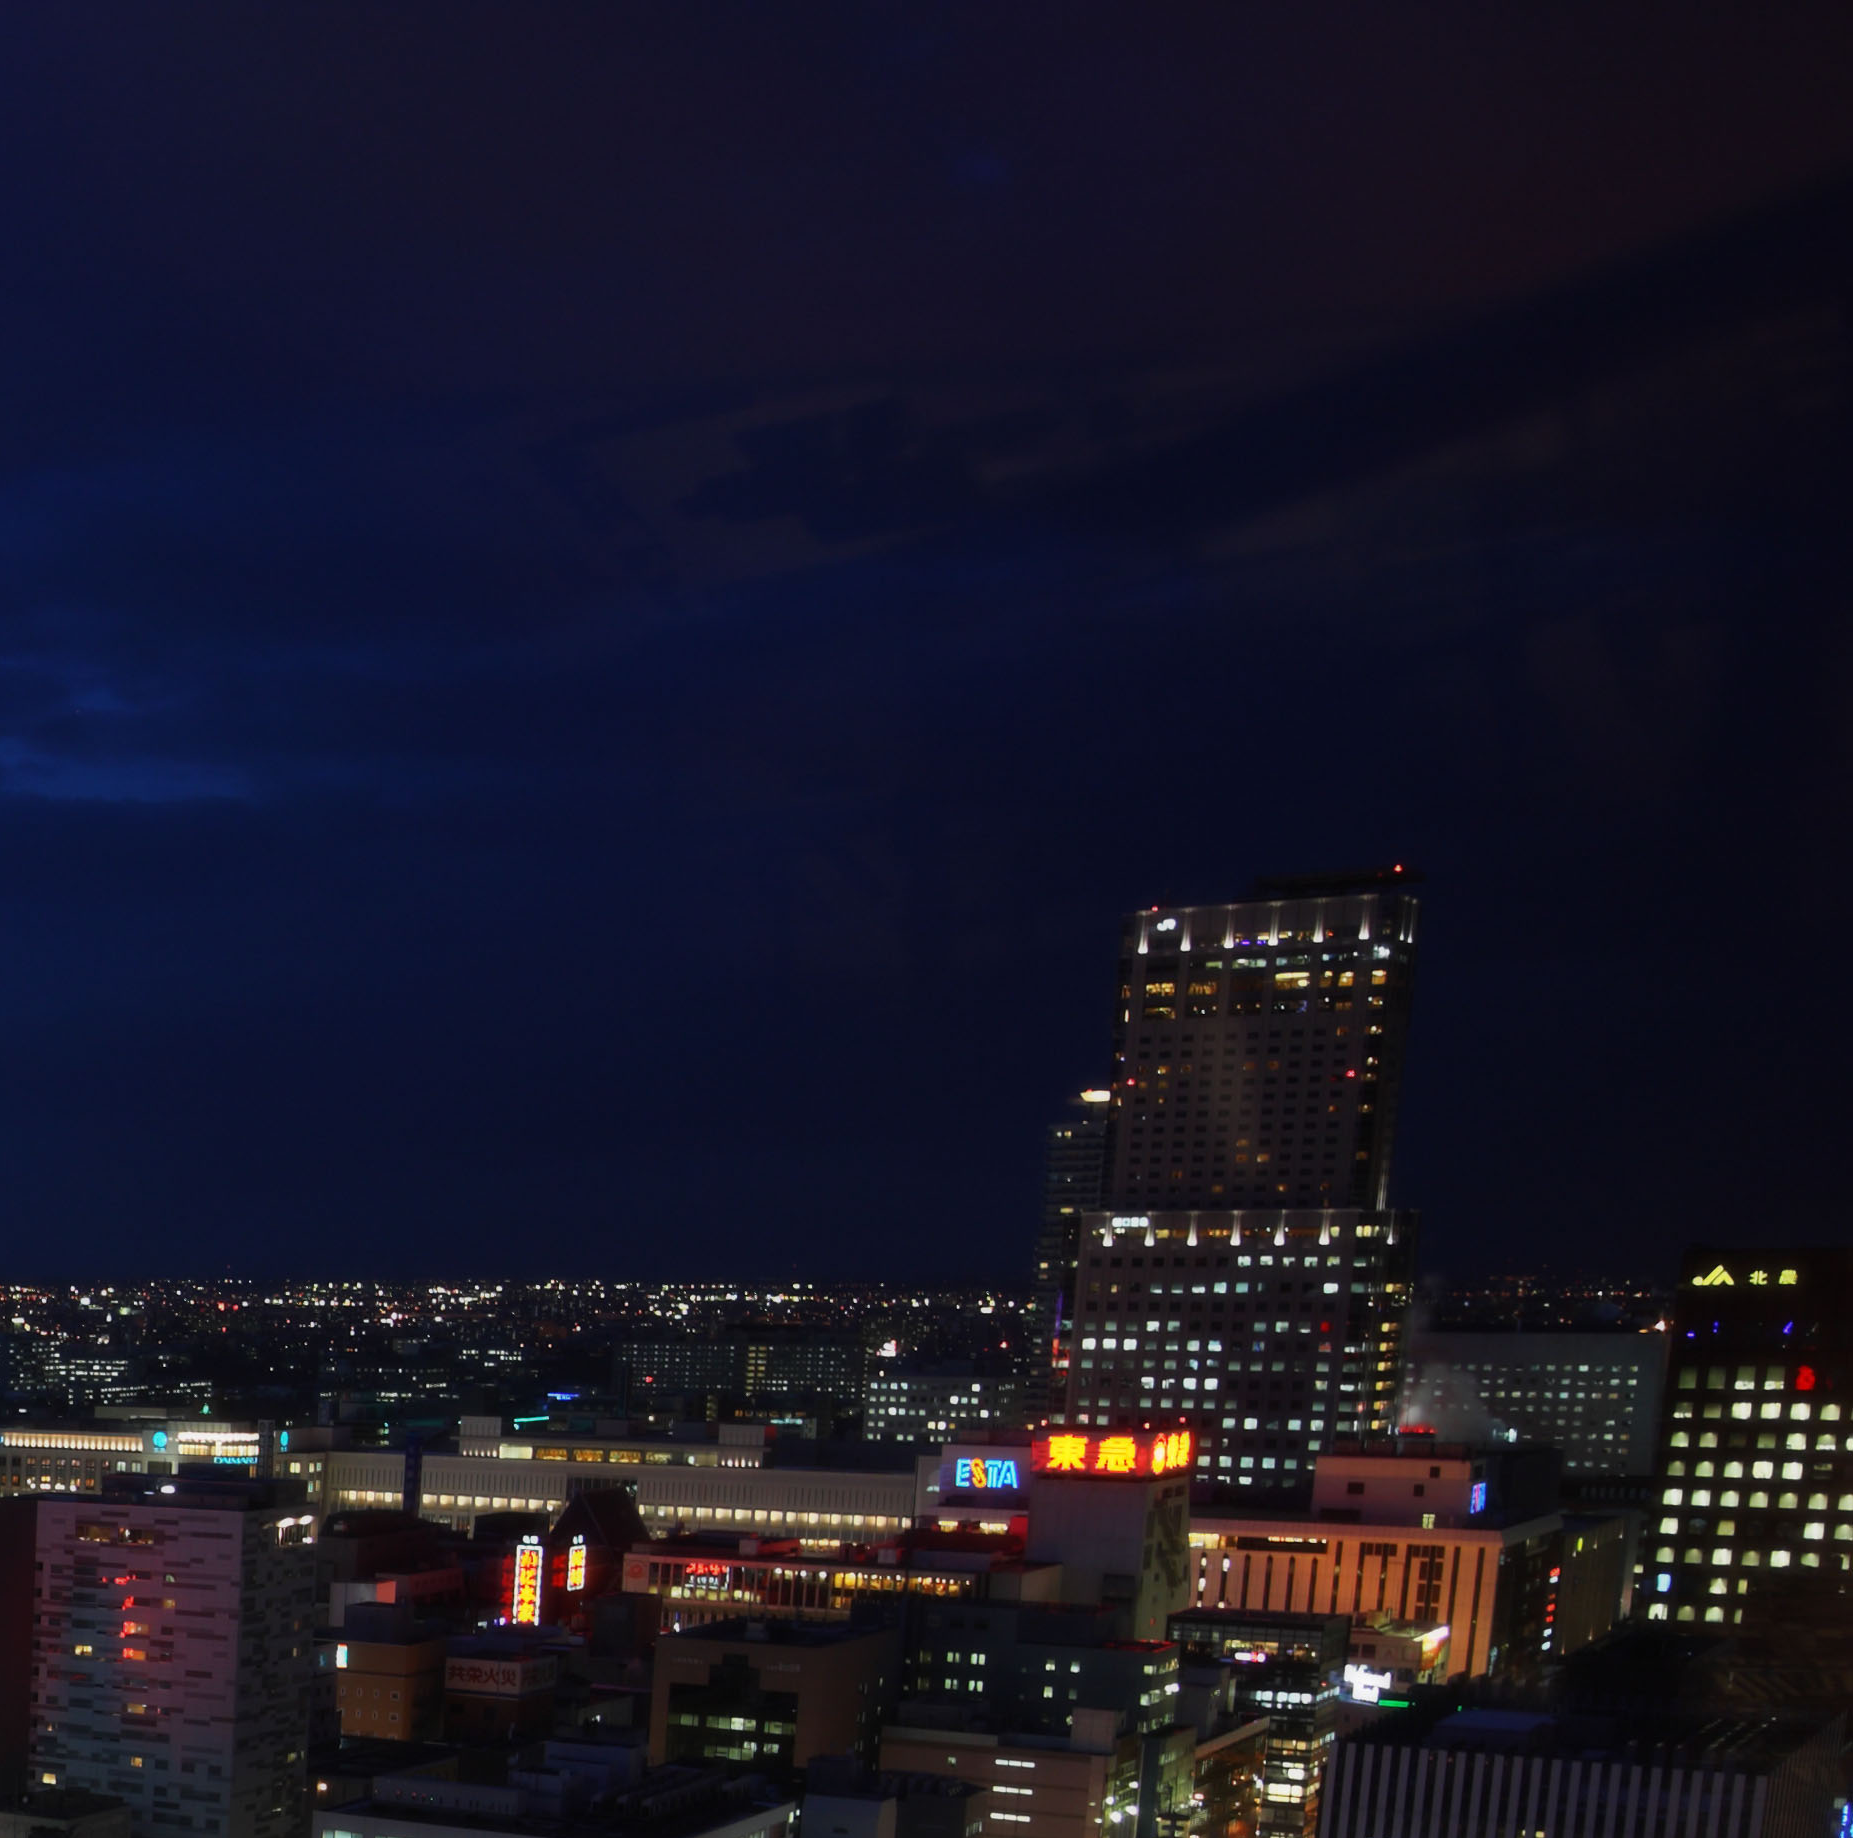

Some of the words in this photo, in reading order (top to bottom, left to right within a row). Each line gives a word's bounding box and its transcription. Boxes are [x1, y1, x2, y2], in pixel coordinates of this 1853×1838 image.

[1047, 1434, 1136, 1473] 東急
[955, 1457, 1019, 1489] ESTA
[448, 1664, 518, 1685] 共栄火災
